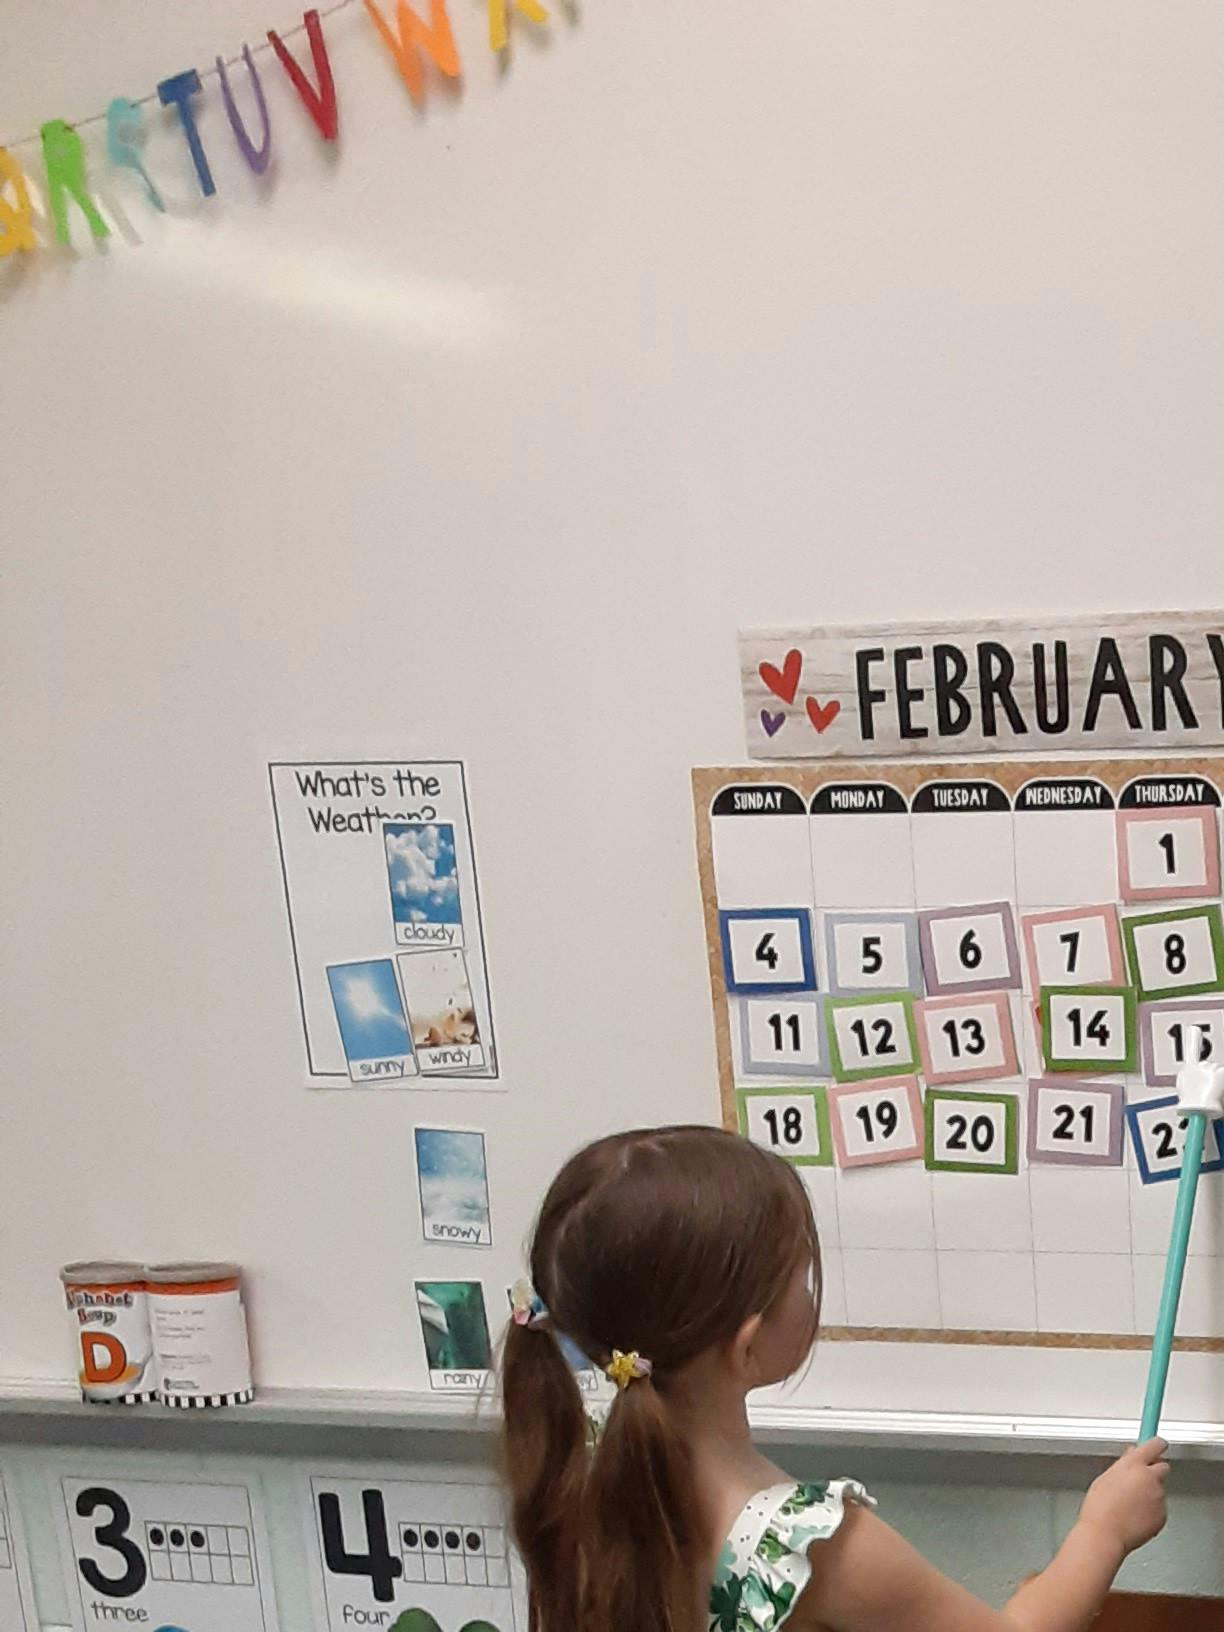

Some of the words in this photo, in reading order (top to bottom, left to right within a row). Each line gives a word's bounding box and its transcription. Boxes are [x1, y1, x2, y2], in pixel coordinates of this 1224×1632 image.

[295, 769, 387, 798] What's
[392, 768, 441, 797] the
[733, 791, 783, 809] SUNDAY
[830, 790, 885, 808] MONDAY
[931, 787, 989, 807] TUESDAY
[1025, 786, 1102, 805] WEDNESDAY
[1134, 783, 1205, 803] THURSDAY
[1159, 834, 1175, 874] 1
[403, 923, 456, 944] cloudy
[755, 932, 778, 969] 4
[862, 937, 883, 974] 5
[959, 930, 982, 969] 6
[1060, 933, 1080, 972] 7
[1164, 934, 1187, 975] 8
[768, 1013, 801, 1051] 11
[850, 1018, 897, 1057] 12
[942, 1018, 985, 1057] 13
[1067, 1009, 1110, 1047] 14
[359, 1058, 407, 1077] sunny
[429, 1049, 472, 1067] windy
[763, 1107, 803, 1147] 18
[856, 1101, 898, 1142] 19
[946, 1114, 995, 1153] 20
[1052, 1104, 1094, 1143] 21
[1152, 1118, 1195, 1159] 2
[432, 1223, 482, 1244] snowy
[80, 1331, 127, 1384] D
[76, 1487, 147, 1598] 3
[318, 1489, 403, 1602] 4
[90, 1600, 150, 1623] three
[342, 1604, 391, 1626] four
